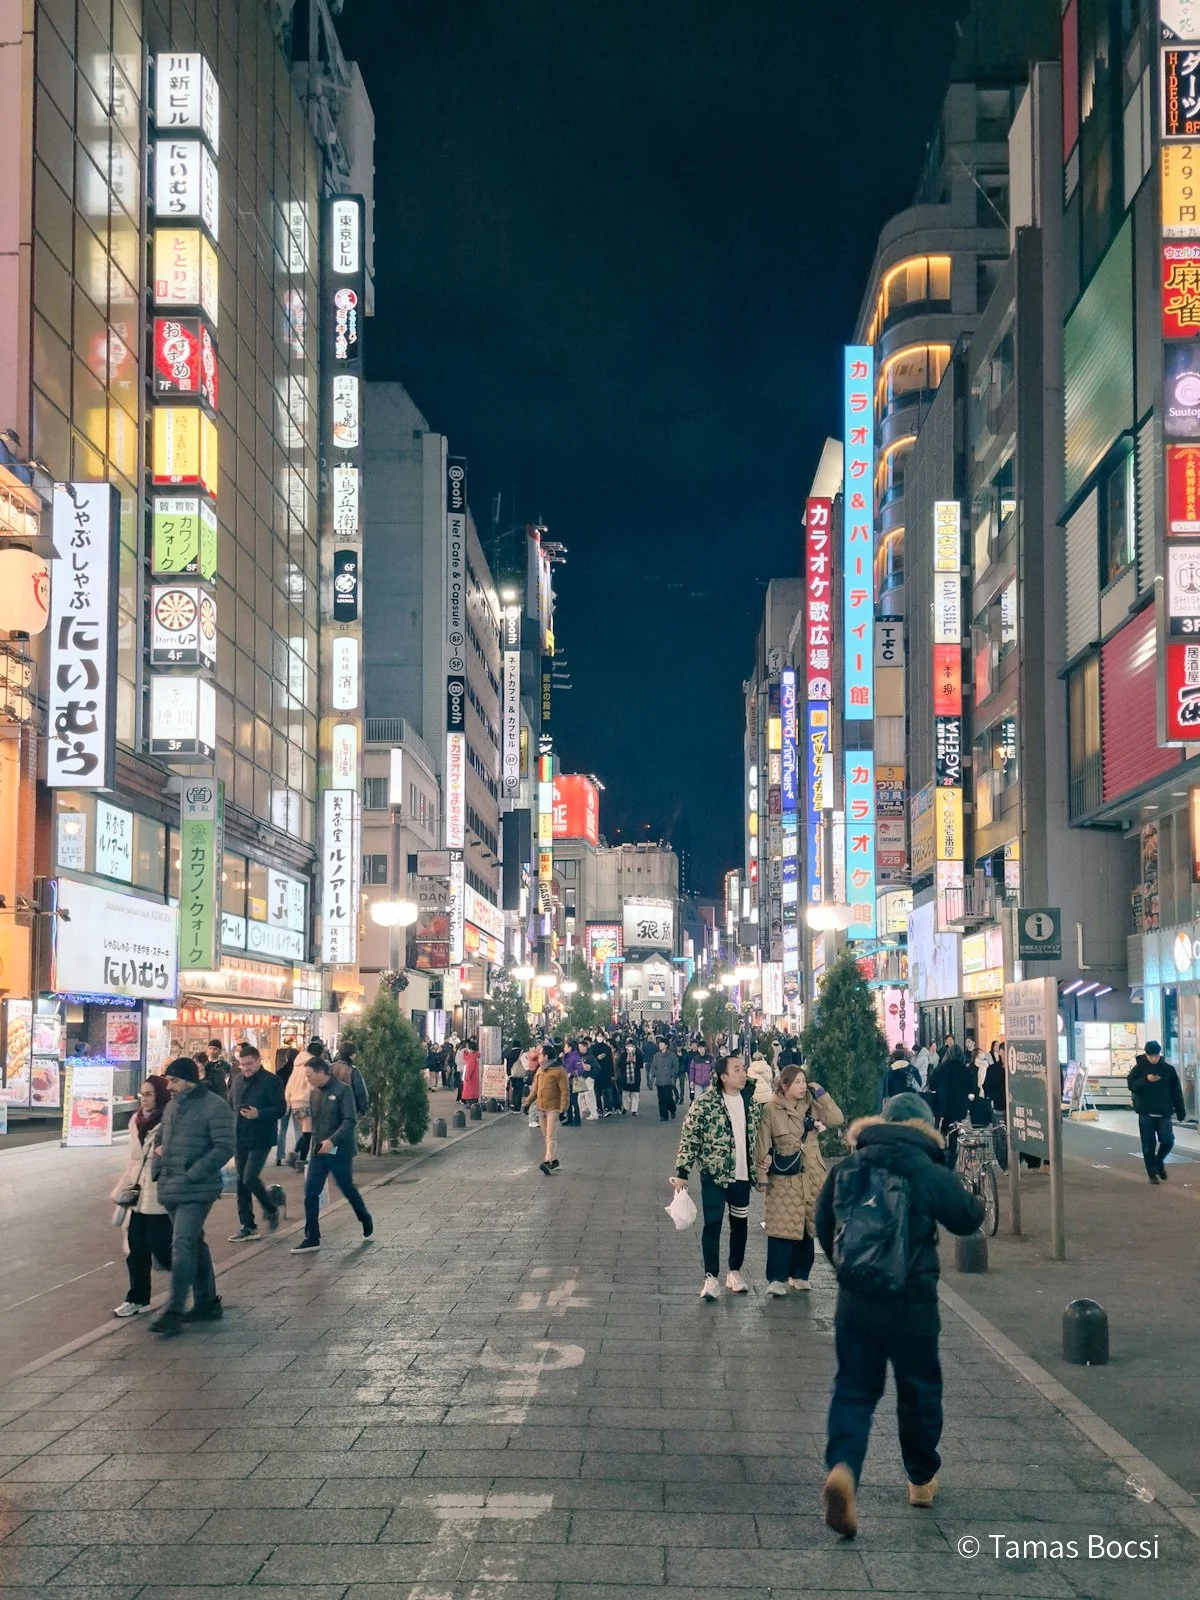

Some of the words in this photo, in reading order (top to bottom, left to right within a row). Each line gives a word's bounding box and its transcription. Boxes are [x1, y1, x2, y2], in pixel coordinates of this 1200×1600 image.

[169, 57, 190, 125] 川新ビル
[1169, 52, 1178, 135] HIDEOUT
[1179, 146, 1196, 222] 299円
[339, 215, 352, 267] 東京ビル
[1165, 262, 1200, 328] 麻雀
[164, 322, 191, 378] おすすめ
[159, 381, 172, 391] 7F
[448, 465, 464, 509] Booth
[69, 490, 92, 610] しゃぶしゃぶ
[451, 519, 461, 538] Net
[849, 360, 870, 706] カラオケ&パーティー館
[451, 542, 461, 568] Cafe
[451, 584, 461, 627] Capsule
[810, 504, 829, 670] カラオケ歌広場
[168, 650, 184, 661] 4F
[178, 634, 197, 645] UP
[1187, 647, 1200, 683] 居酒屋
[54, 615, 100, 776] にいむら
[448, 681, 464, 724] Booth
[168, 740, 182, 750] 3F
[945, 720, 960, 778] AGEHA
[450, 852, 462, 861] 2F
[850, 766, 872, 924] カラオケ館
[188, 846, 206, 963] カワノ・クォーク
[329, 848, 347, 919] ルノアール
[419, 893, 447, 901] DAN
[103, 956, 169, 990] にいむら
